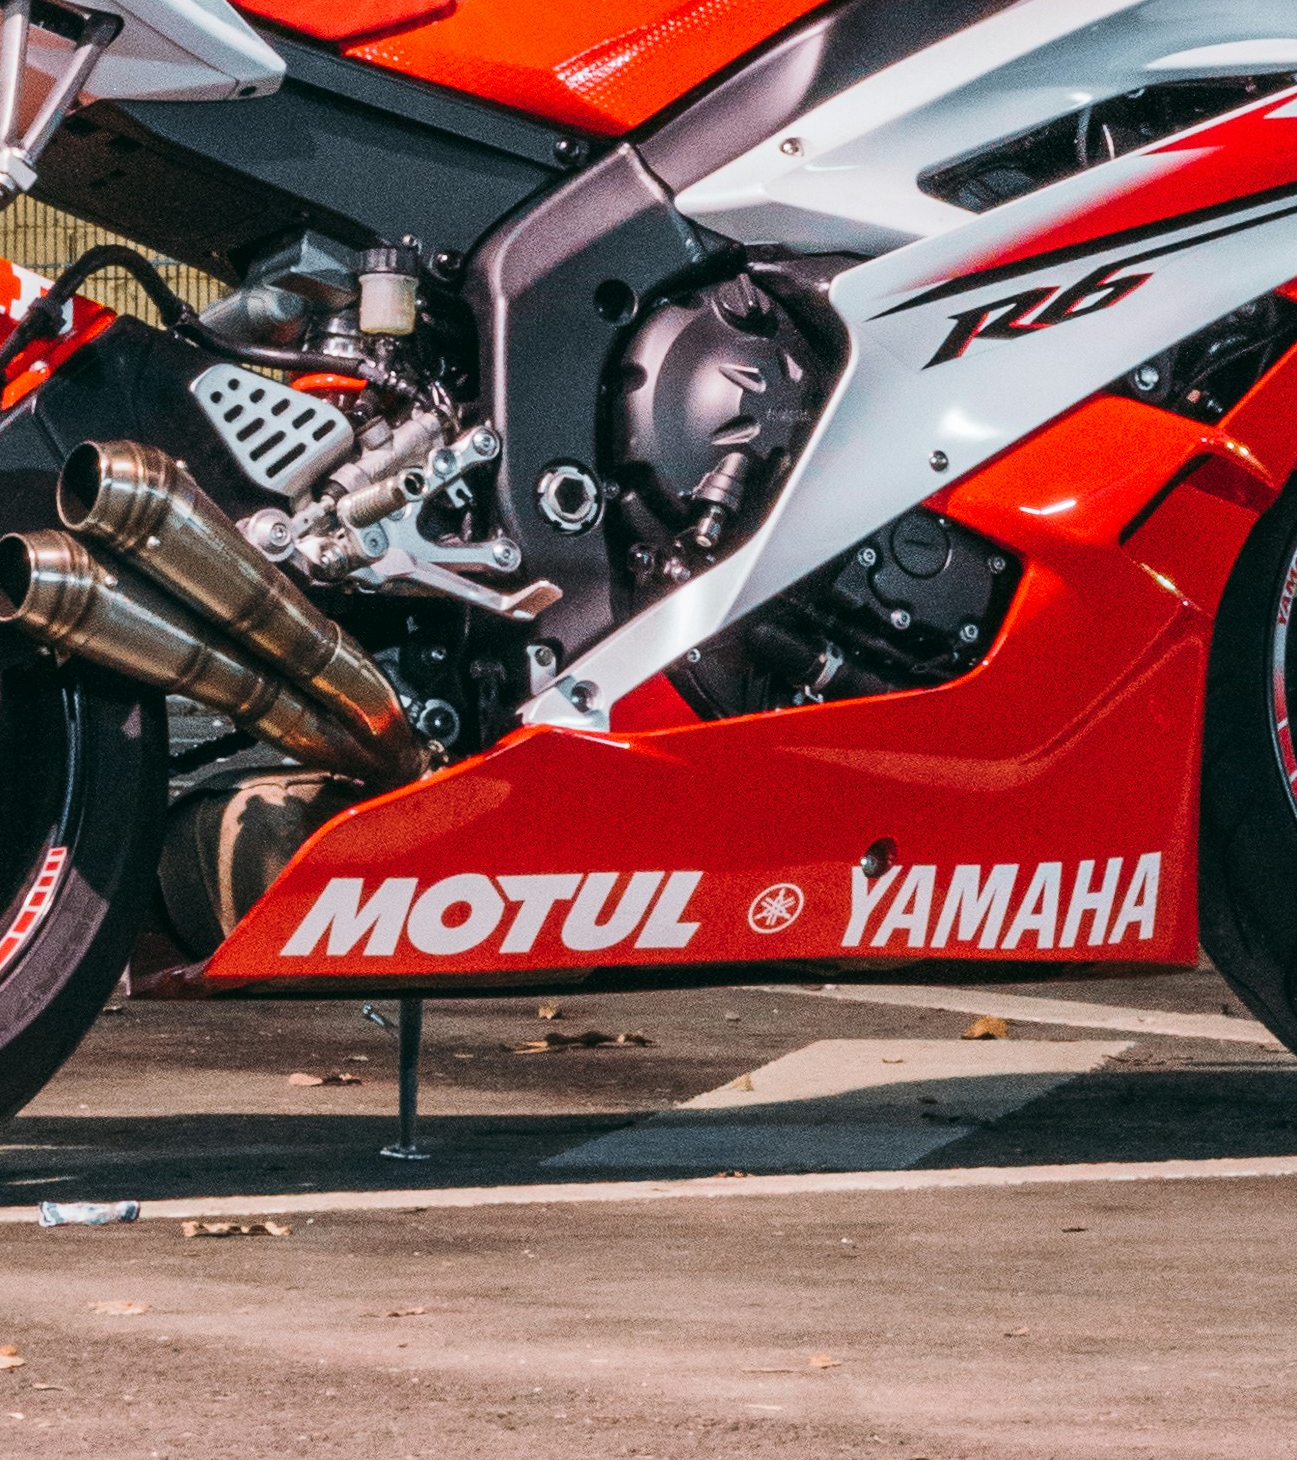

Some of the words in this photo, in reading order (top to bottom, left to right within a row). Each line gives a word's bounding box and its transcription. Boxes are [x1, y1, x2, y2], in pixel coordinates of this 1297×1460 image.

[921, 272, 1154, 370] R6
[279, 871, 704, 957] MOTUL
[841, 851, 1162, 950] YAMAHA
